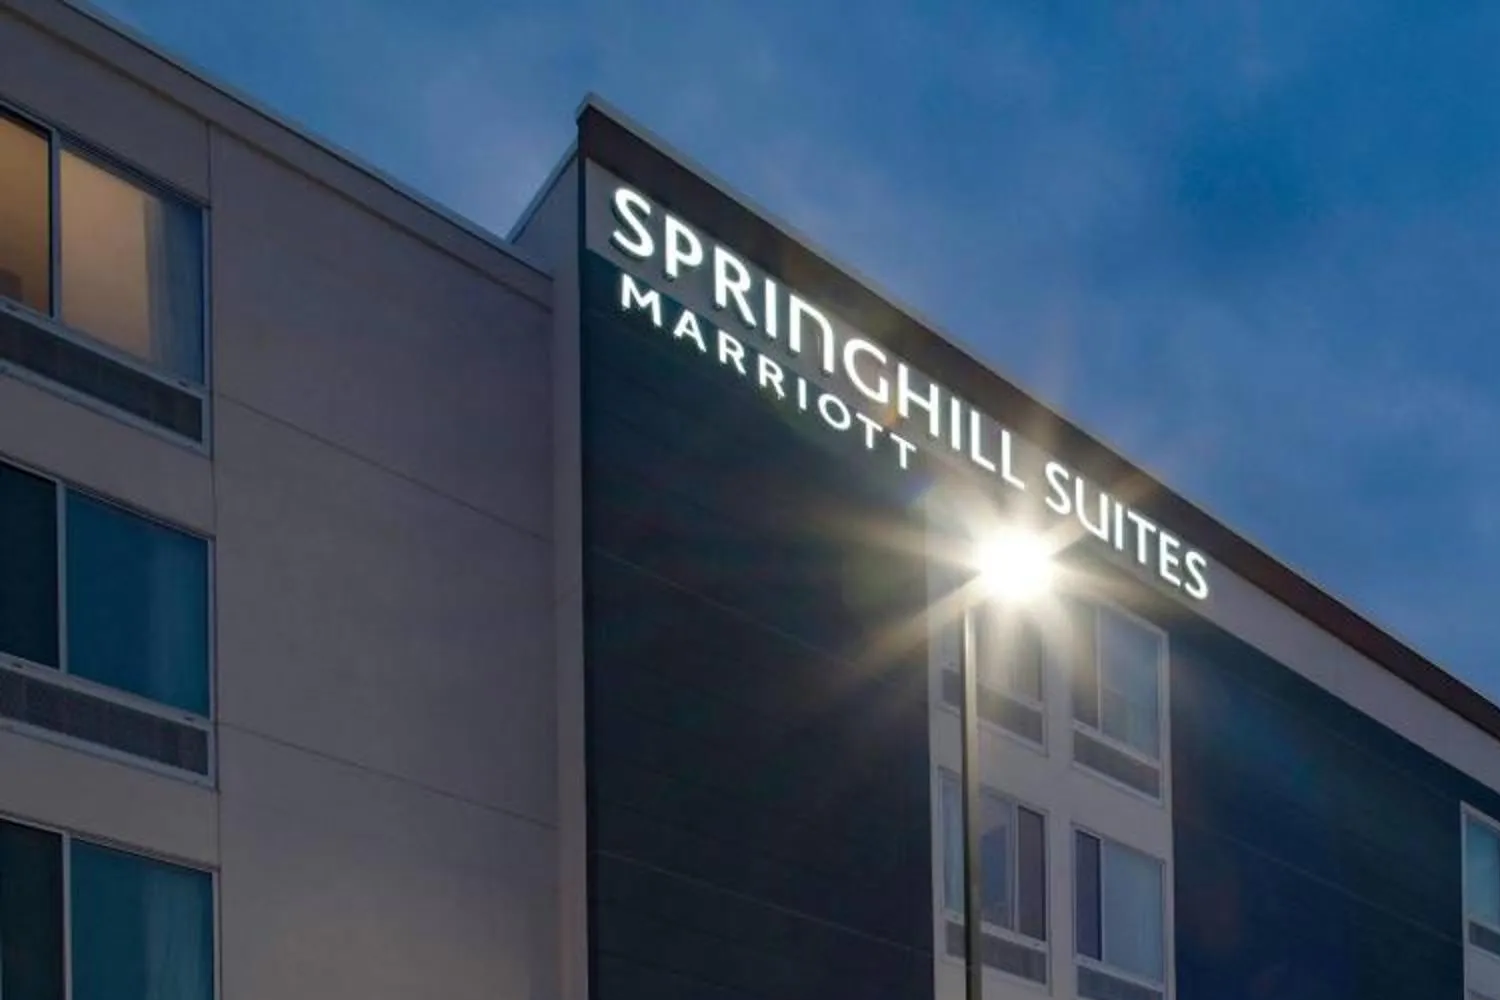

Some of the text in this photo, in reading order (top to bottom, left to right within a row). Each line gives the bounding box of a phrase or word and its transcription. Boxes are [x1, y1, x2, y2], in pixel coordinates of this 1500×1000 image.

[611, 187, 1209, 600] SPRINGHILL SUITES
[620, 273, 917, 470] MARRIOTT
